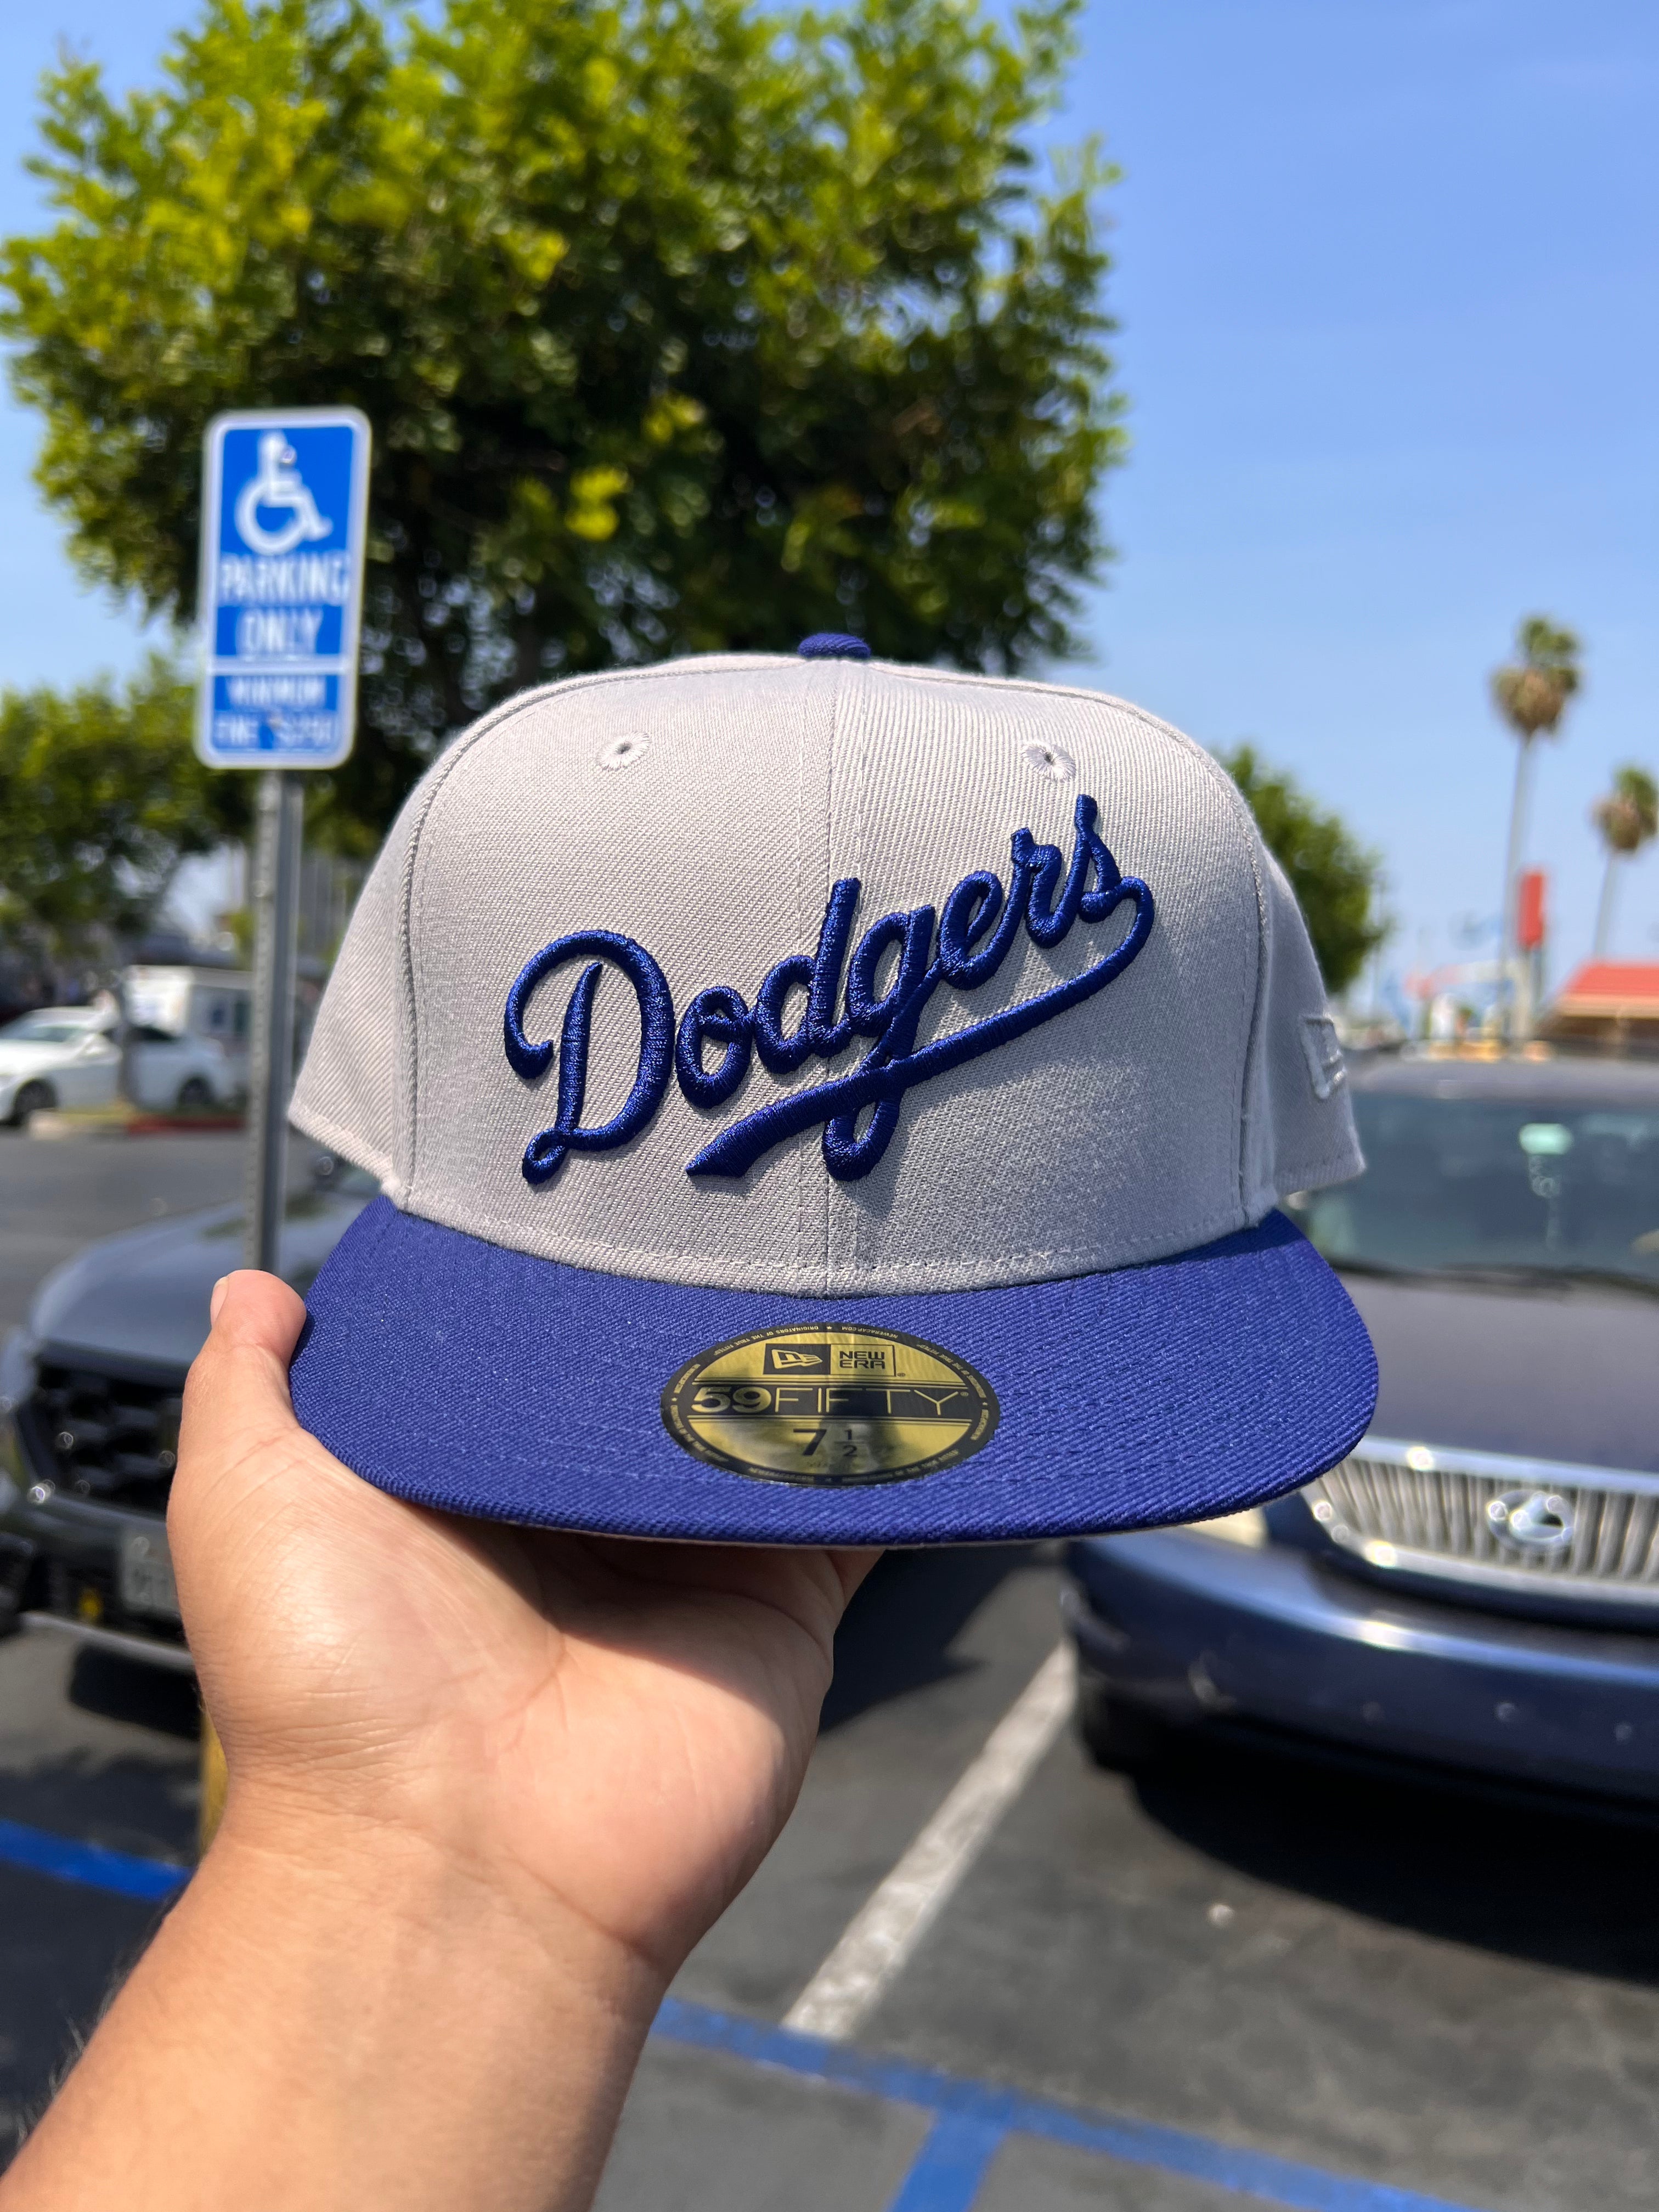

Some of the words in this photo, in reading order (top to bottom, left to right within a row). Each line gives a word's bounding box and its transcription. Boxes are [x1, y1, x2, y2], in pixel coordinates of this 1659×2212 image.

[221, 554, 350, 602] PARKING
[238, 609, 323, 657] ONLY
[504, 793, 1154, 1184] Dodgers
[776, 1325, 819, 1334] ORIGINATORS
[842, 1325, 898, 1339] NEWERACAP.COM
[839, 1350, 885, 1360] NEW
[839, 1359, 885, 1369] ERA
[691, 1386, 959, 1416] 59FIFTY
[793, 1429, 827, 1456] 7
